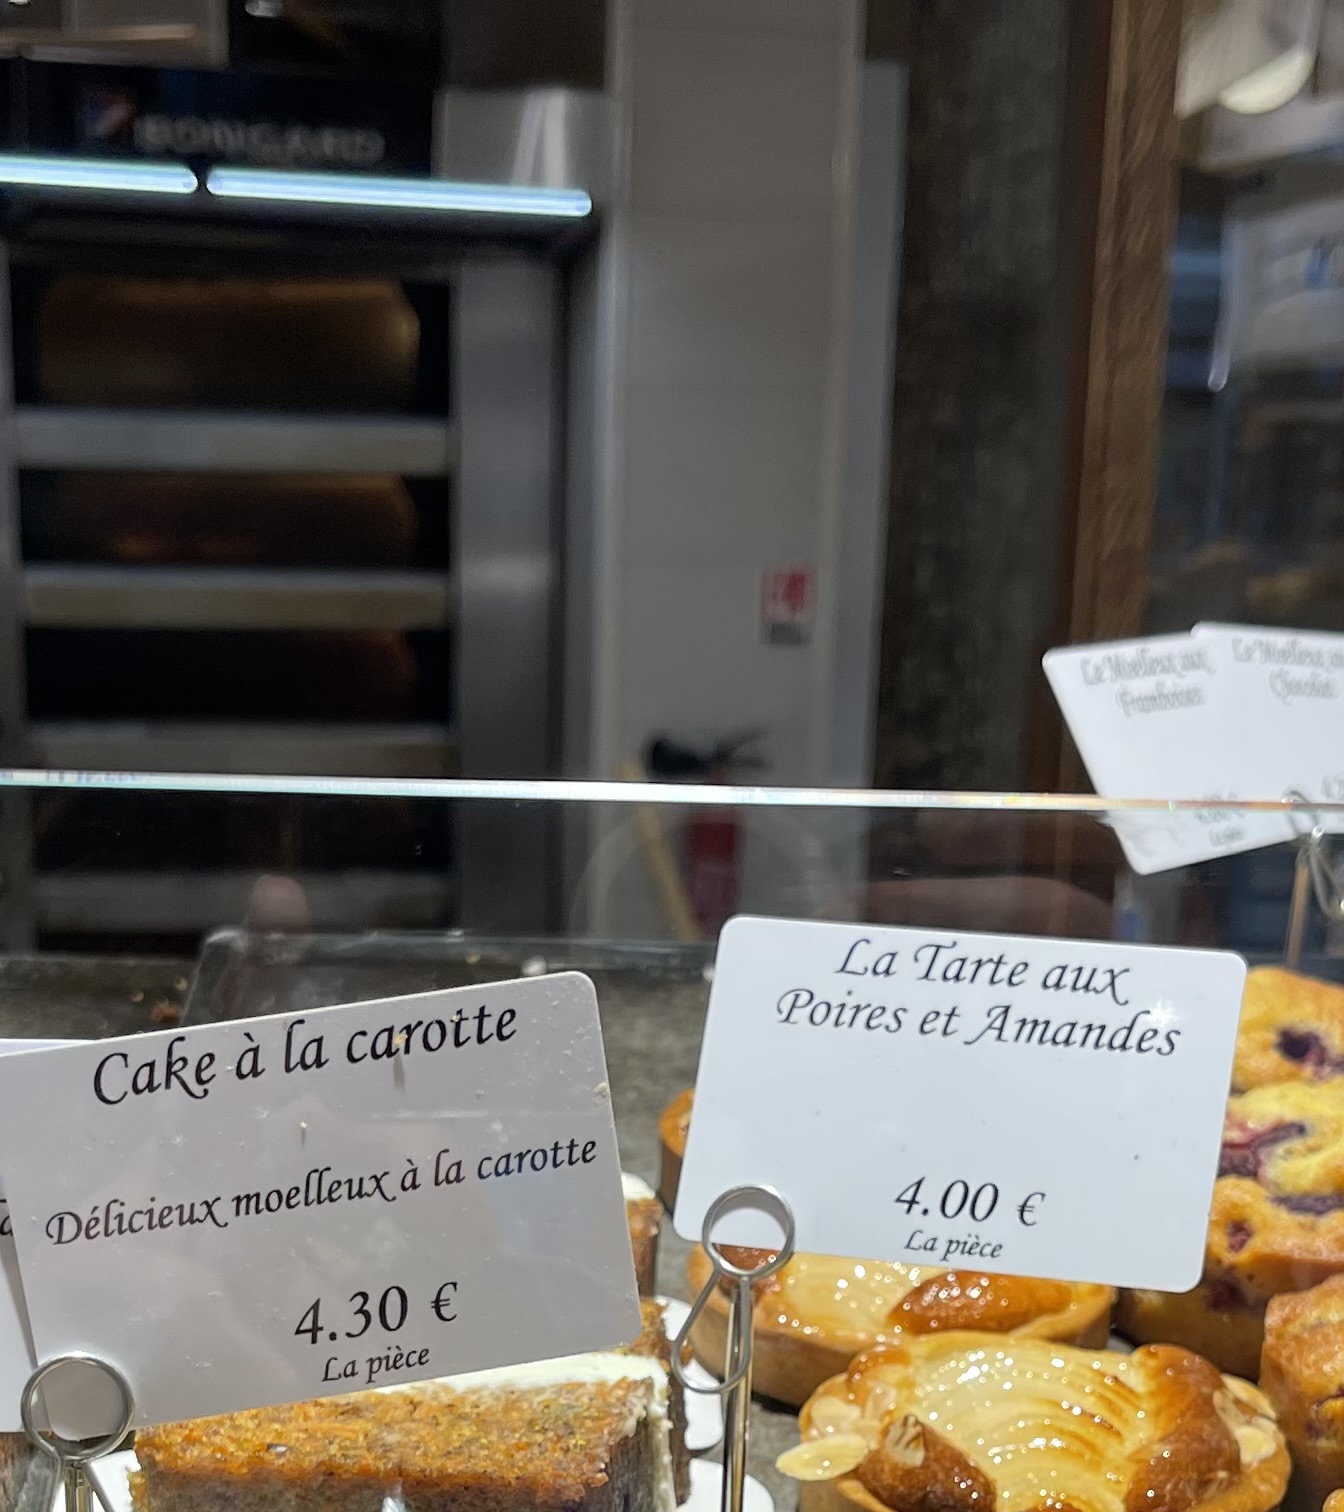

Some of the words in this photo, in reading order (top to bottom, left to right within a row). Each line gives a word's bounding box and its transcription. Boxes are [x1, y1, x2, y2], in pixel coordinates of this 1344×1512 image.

[834, 938, 898, 978] La
[913, 944, 1029, 988] Tarte
[1040, 964, 1130, 1007] aux
[93, 1036, 217, 1106] Cake
[235, 1032, 266, 1081] à
[284, 1019, 330, 1074] la
[346, 1004, 517, 1065] carotte
[776, 988, 908, 1034] Poires
[918, 1005, 961, 1038] et
[963, 1004, 1182, 1057] Amandes
[45, 1196, 229, 1246] Délicieux
[231, 1166, 397, 1218] moelleux
[400, 1158, 422, 1193] à
[433, 1148, 466, 1187] la
[477, 1138, 597, 1180] carotte
[894, 1176, 1000, 1223] 4.00
[1016, 1191, 1047, 1227] €
[903, 1229, 938, 1252] La
[940, 1233, 1003, 1262] pièce
[293, 1285, 409, 1345] 4.30
[430, 1281, 458, 1322] €
[321, 1356, 359, 1383] La
[365, 1345, 430, 1385] pièce
